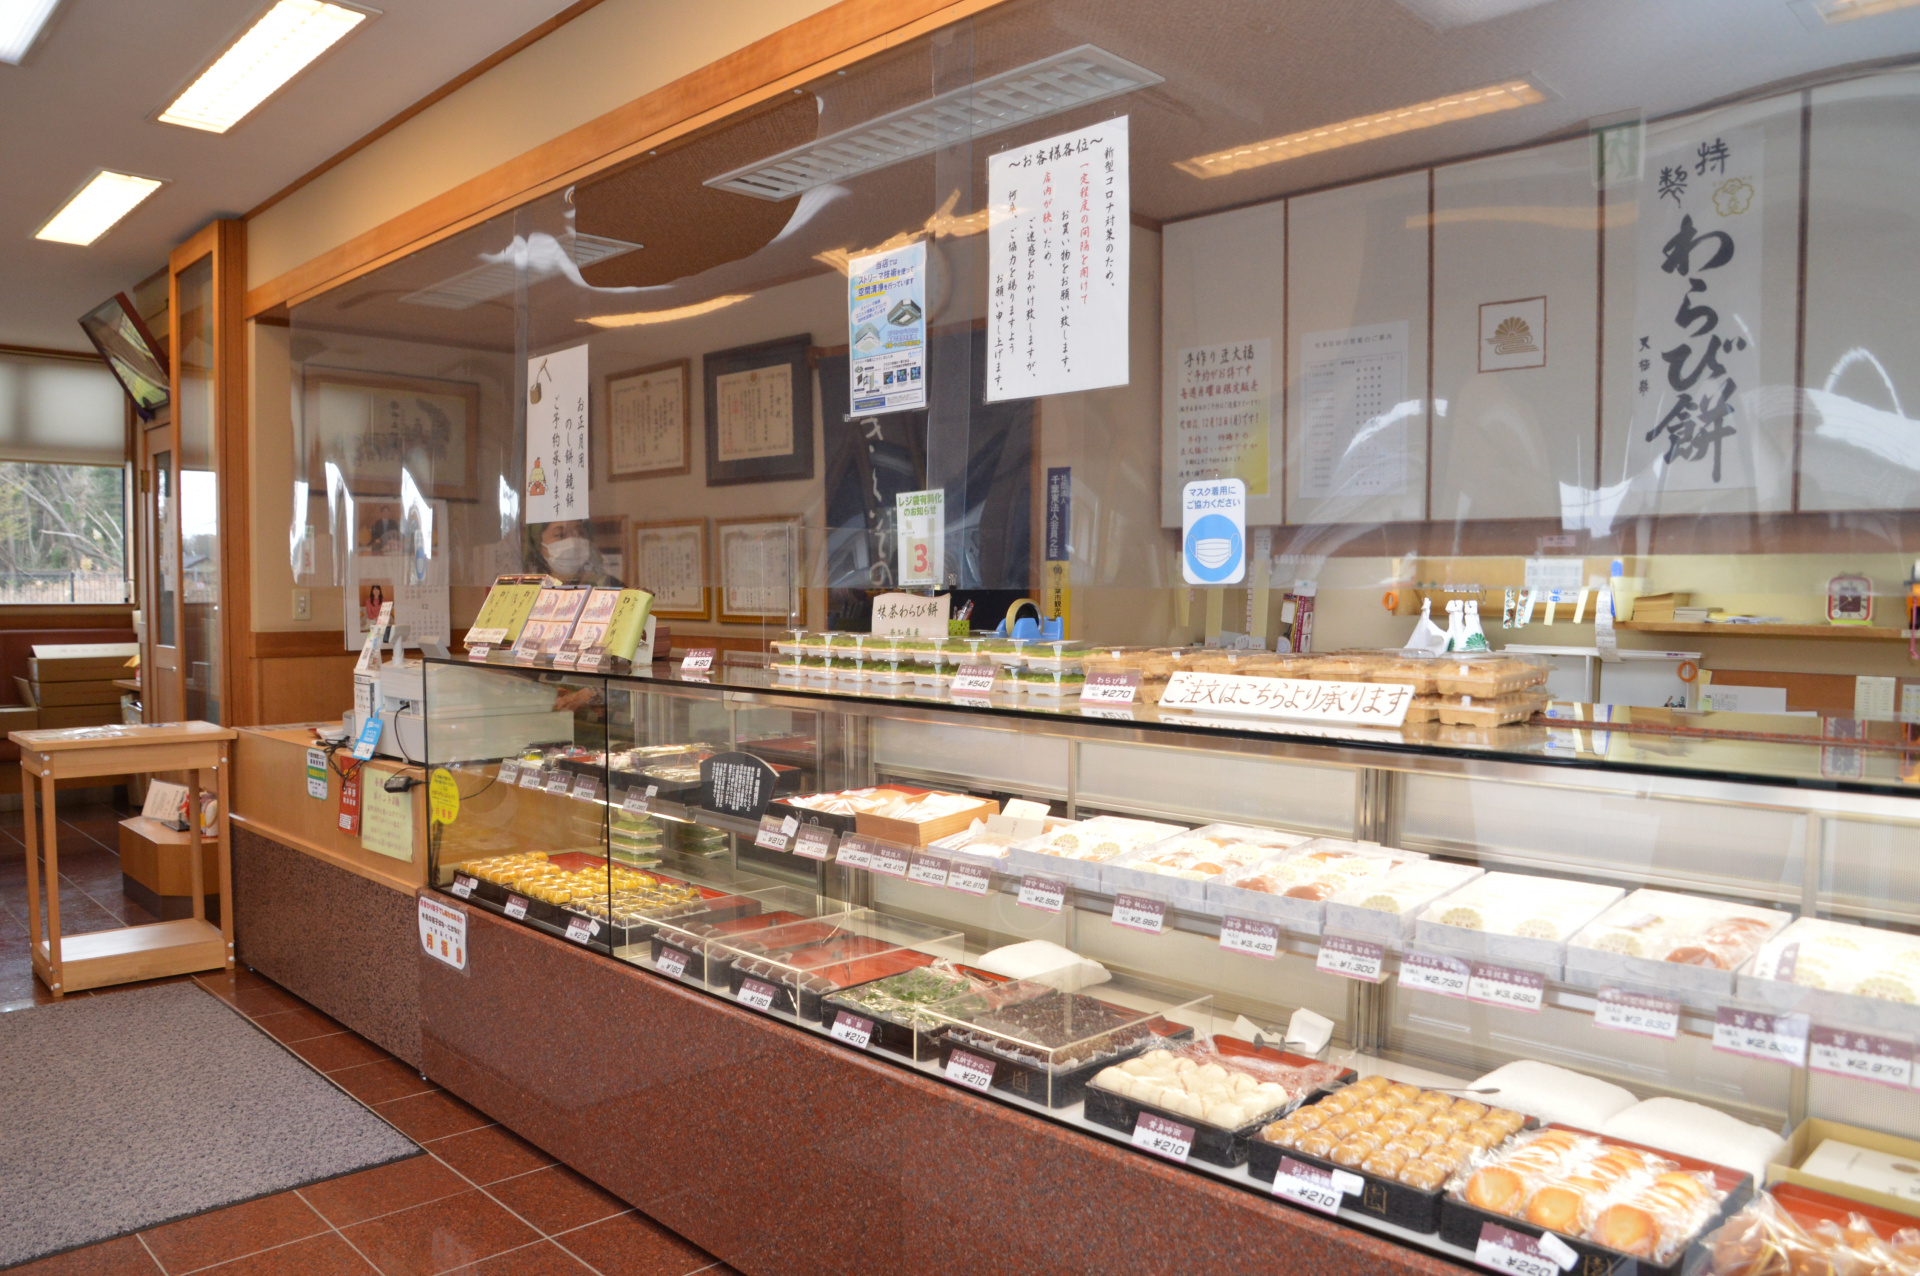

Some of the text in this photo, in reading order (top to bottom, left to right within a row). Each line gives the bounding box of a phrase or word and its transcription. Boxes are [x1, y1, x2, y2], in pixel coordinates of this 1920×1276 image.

[1042, 171, 1053, 267] 店内が狭いため、
[1104, 147, 1115, 287] 新型コロナ対策のため、
[1079, 162, 1090, 304] 一定程度の間隔を開けて
[875, 258, 898, 270] 当店では
[858, 265, 915, 285] ストリーマ技術を使って
[858, 277, 914, 297] 空間清浄を行っています
[1060, 210, 1071, 373] お買い物をお願い致します。
[1026, 218, 1036, 378] ご迷惑をおかけ致しますが、
[994, 273, 1005, 391] お願い申し上げます。
[1183, 345, 1255, 368] 手作り豆大福
[1645, 213, 1747, 483] わらび餅
[1187, 364, 1252, 384] ご予約がお得です
[577, 397, 585, 468] お正月用
[552, 395, 562, 517] ご予約承ります
[898, 493, 943, 507] レジ袋有料化
[1188, 485, 1237, 497] マスク着用に
[904, 505, 937, 517] のお知らせ
[1186, 498, 1241, 510] ご協力ください
[914, 543, 928, 573] 3
[877, 601, 939, 619] 抹茶わらび餅
[967, 679, 990, 688] ¥540
[1096, 676, 1128, 685] わらび餅
[1101, 689, 1131, 699] ¥270
[1163, 674, 1408, 717] ご注文はこちらより承ります
[768, 836, 785, 846] ¥810
[844, 1030, 867, 1044] ¥210
[953, 1055, 990, 1072] 大納言かのこ
[961, 1071, 988, 1086] ¥210
[1152, 1137, 1185, 1156] ¥210
[1298, 1186, 1336, 1208] ¥210
[1505, 1255, 1552, 1276] ¥220
